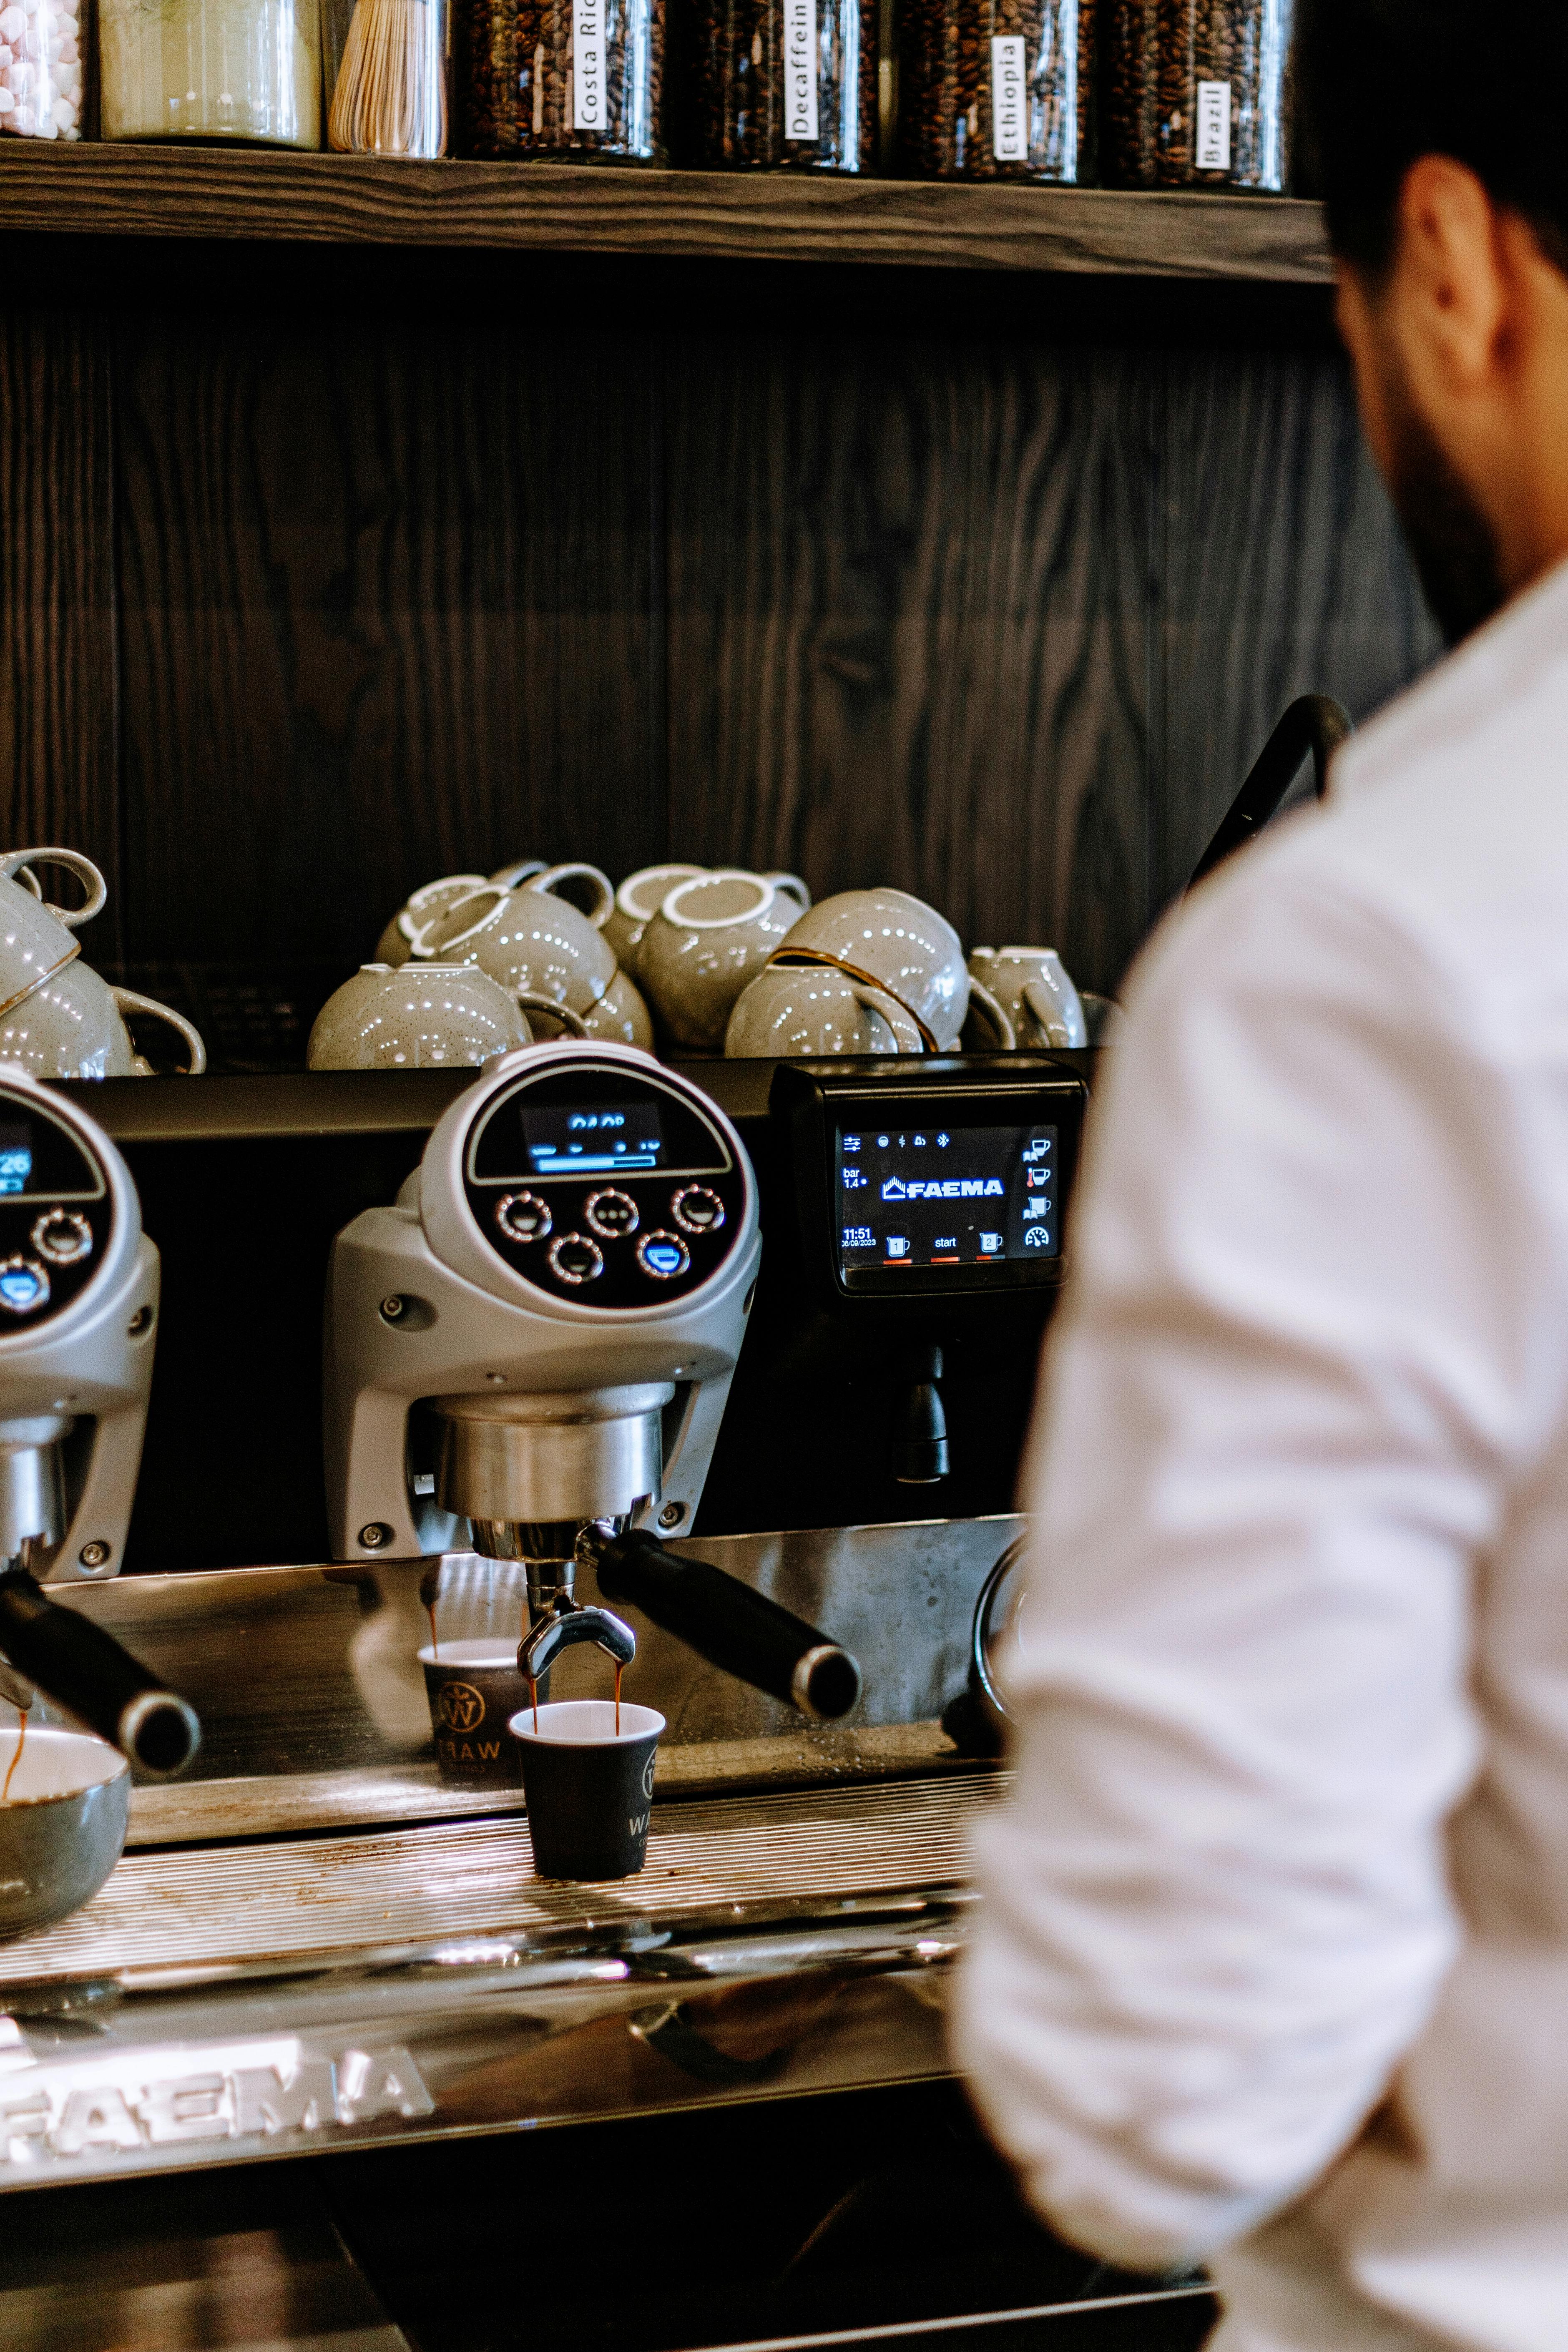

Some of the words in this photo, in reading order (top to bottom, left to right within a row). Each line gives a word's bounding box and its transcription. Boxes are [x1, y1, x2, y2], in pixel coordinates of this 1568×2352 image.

[791, 5, 808, 133] Decaffein
[581, 52, 597, 123] Costa
[999, 45, 1020, 153] Ethiopia
[1204, 90, 1221, 162] Brazil
[843, 1168, 859, 1178] bar
[844, 1179, 859, 1188] 1.4
[907, 1180, 1003, 1198] FAEMA
[844, 1228, 870, 1239] 11:51
[935, 1237, 956, 1247] start
[894, 1242, 898, 1251] 1
[0, 2047, 435, 2159] FAEMA
